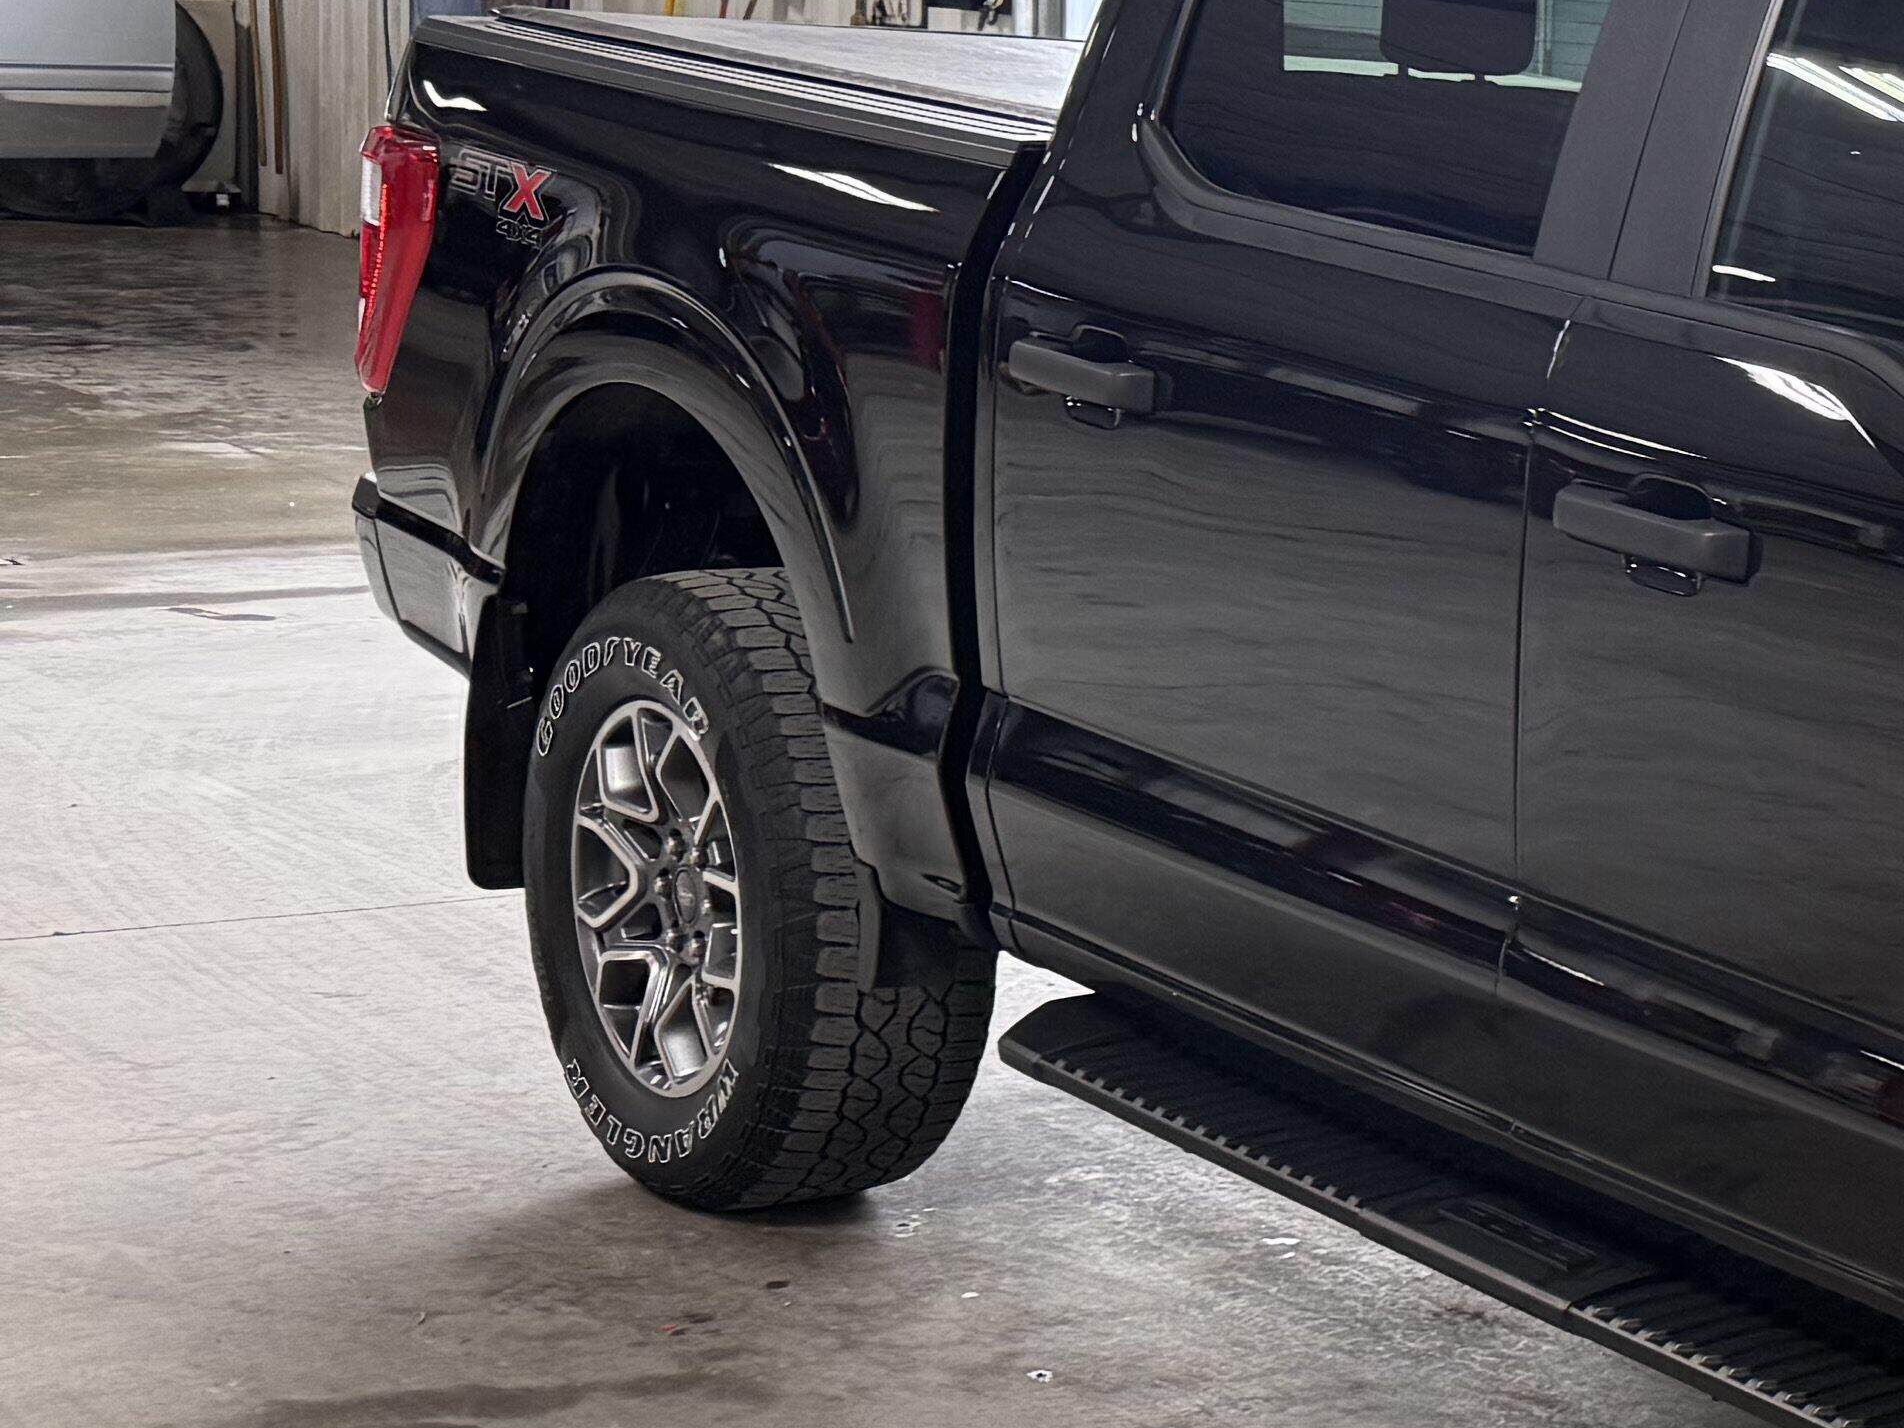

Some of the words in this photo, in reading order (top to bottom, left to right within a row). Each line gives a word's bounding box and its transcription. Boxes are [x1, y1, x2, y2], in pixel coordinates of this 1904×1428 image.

[448, 146, 553, 222] STX
[536, 636, 709, 757] GOODYEAR
[566, 1058, 739, 1164] WRANGLER
